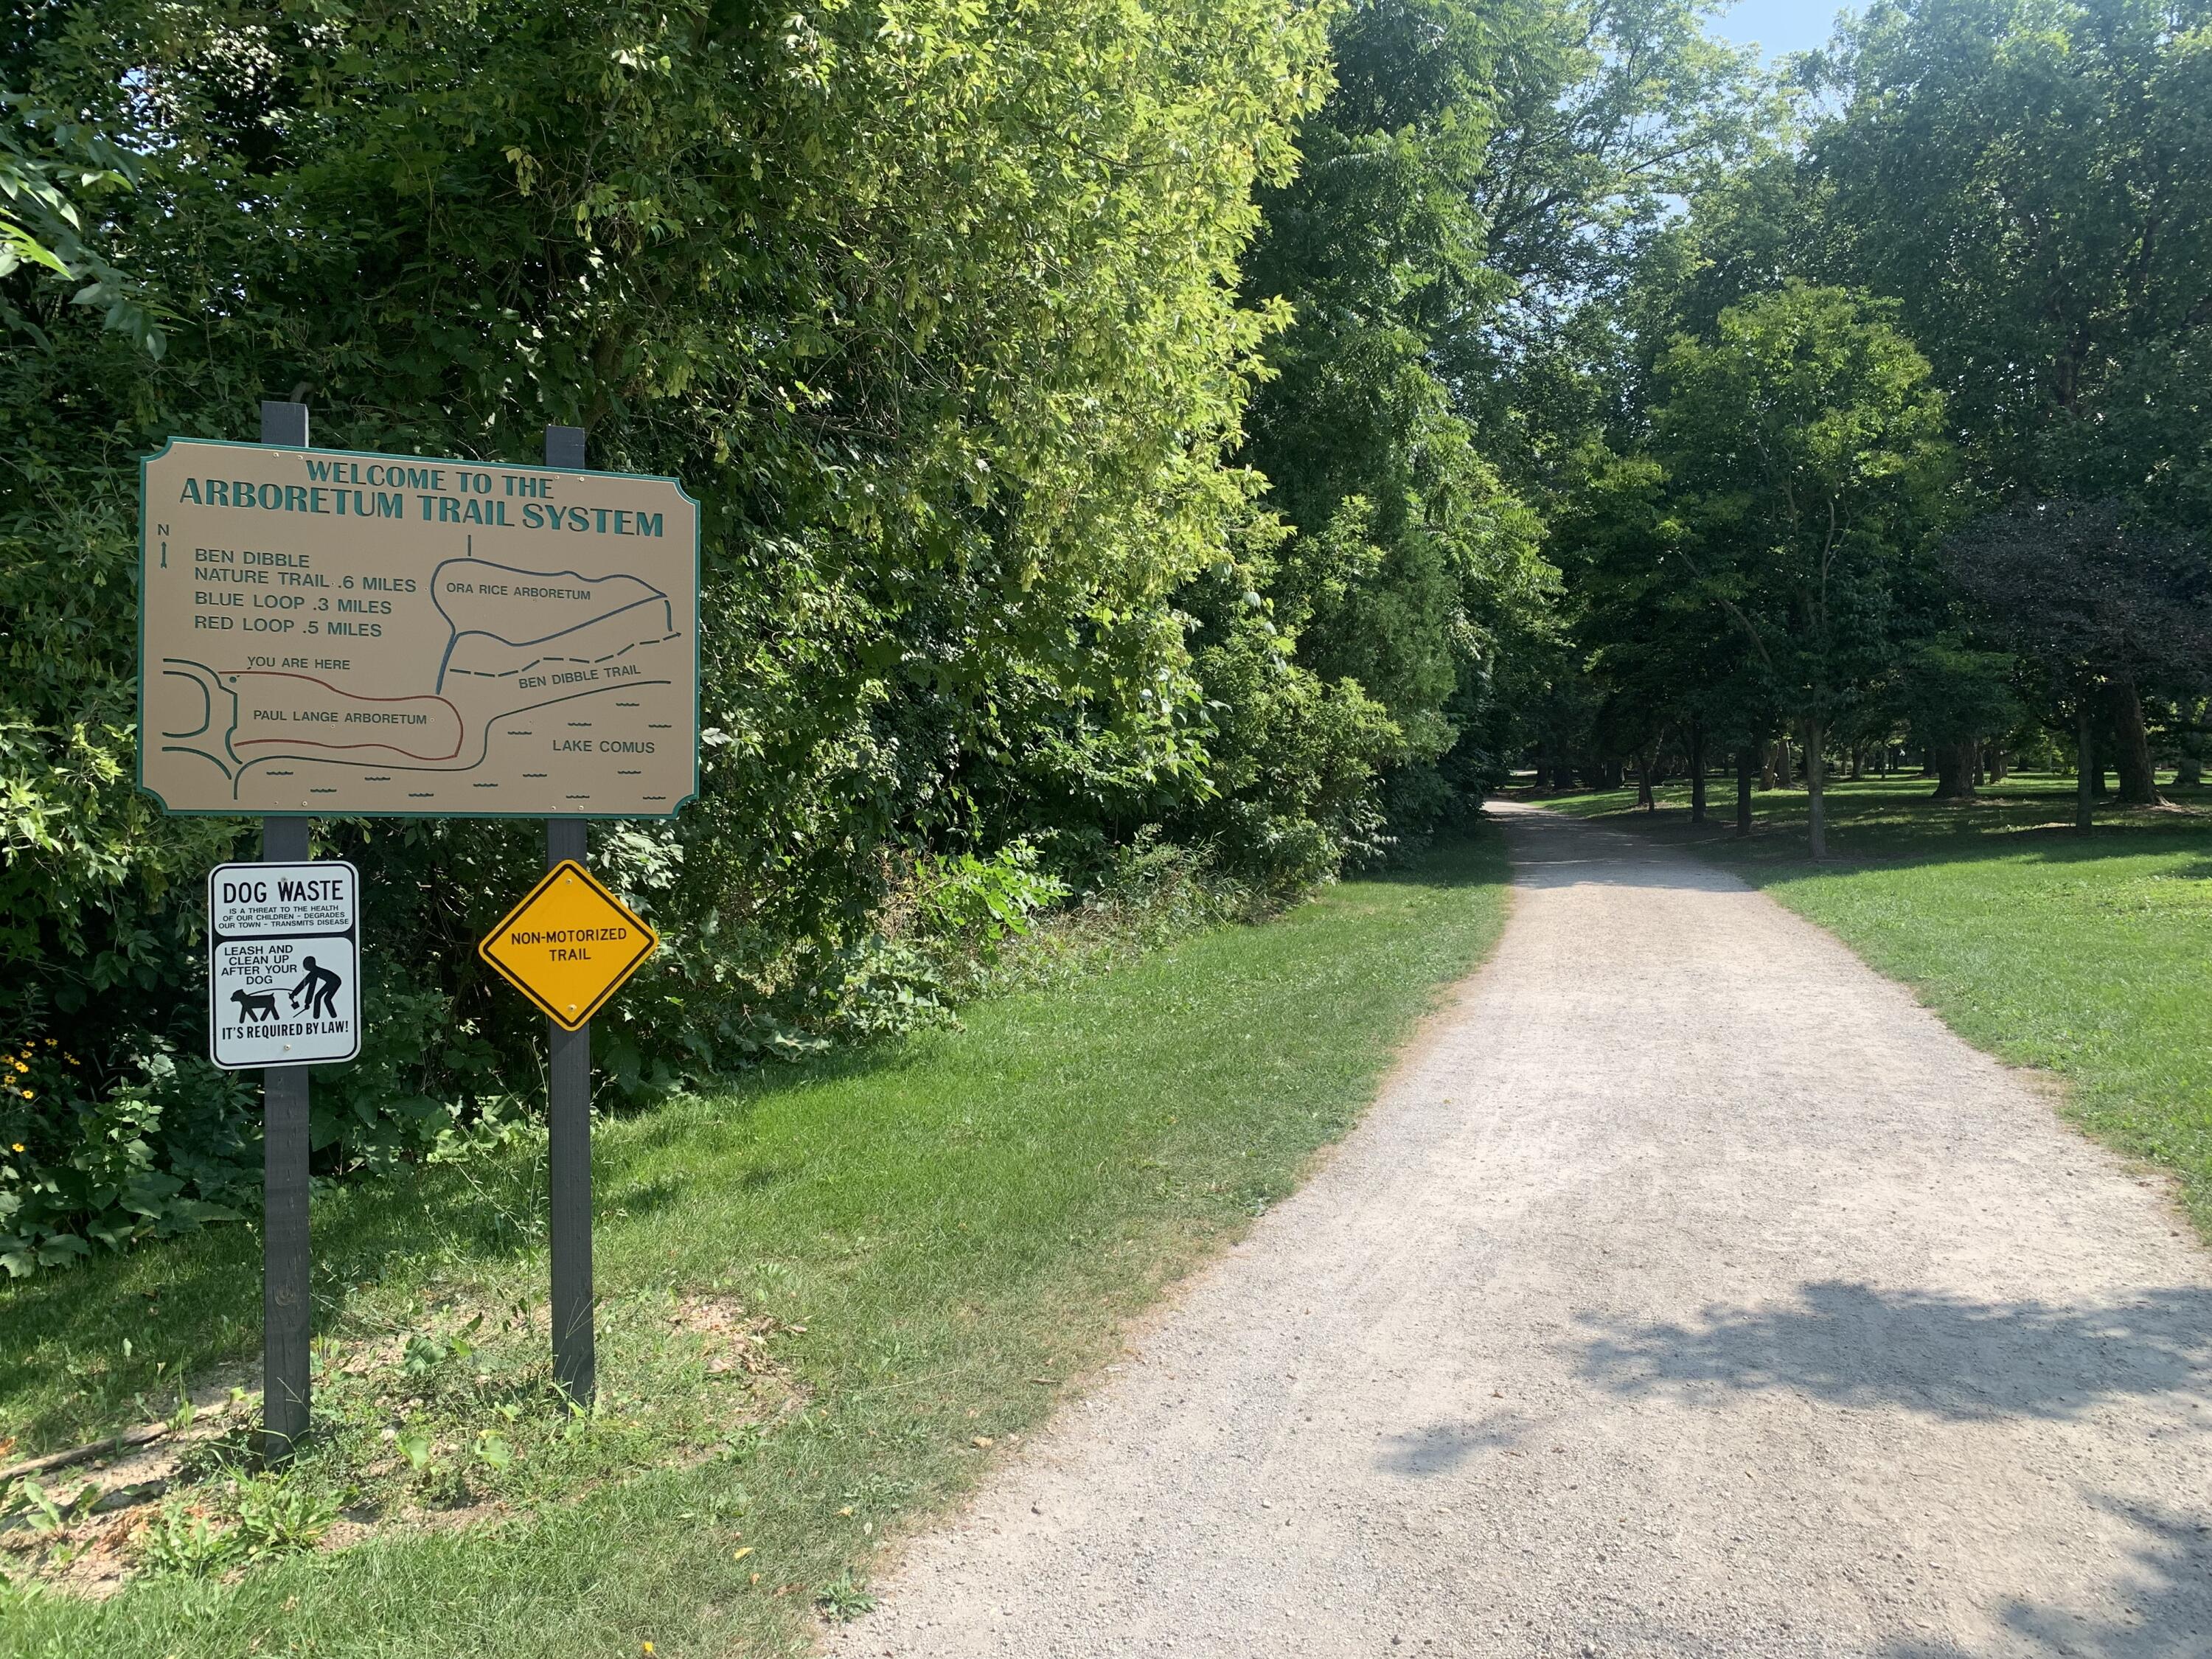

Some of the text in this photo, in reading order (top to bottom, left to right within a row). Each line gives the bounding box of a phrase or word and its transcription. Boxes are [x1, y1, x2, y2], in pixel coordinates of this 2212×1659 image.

[306, 460, 554, 498] WELCOME TO THE
[179, 478, 663, 537] ARBORETUM TRAIL SYSTEM
[157, 524, 170, 536] N
[195, 549, 310, 568] BEN DIBBLE
[195, 567, 416, 592] NATURE TRAIL .6 MILES
[447, 582, 591, 600] ORA RICE ARBORETUM
[195, 591, 392, 614] BLUE LOOP .3 MILES
[195, 616, 382, 637] RED LOOP .5 MILES
[248, 656, 350, 669] YOU ARE HERE
[518, 665, 641, 689] BEN DIBBLE TRAIL
[254, 710, 427, 725] PAUL LANGE ARBORETUM
[553, 740, 655, 754] LAKE COMUS
[223, 880, 343, 903] DOG WASTE
[512, 928, 626, 945] NON-MOTORIZED
[225, 945, 293, 956] LEASH AND
[549, 948, 591, 961] TRAIL
[221, 964, 297, 975] AFTER YOUR
[229, 956, 289, 966] CLEAN UP
[246, 975, 272, 985] DOG
[222, 1020, 349, 1040] IT'S REQUIRED BY LAW!
